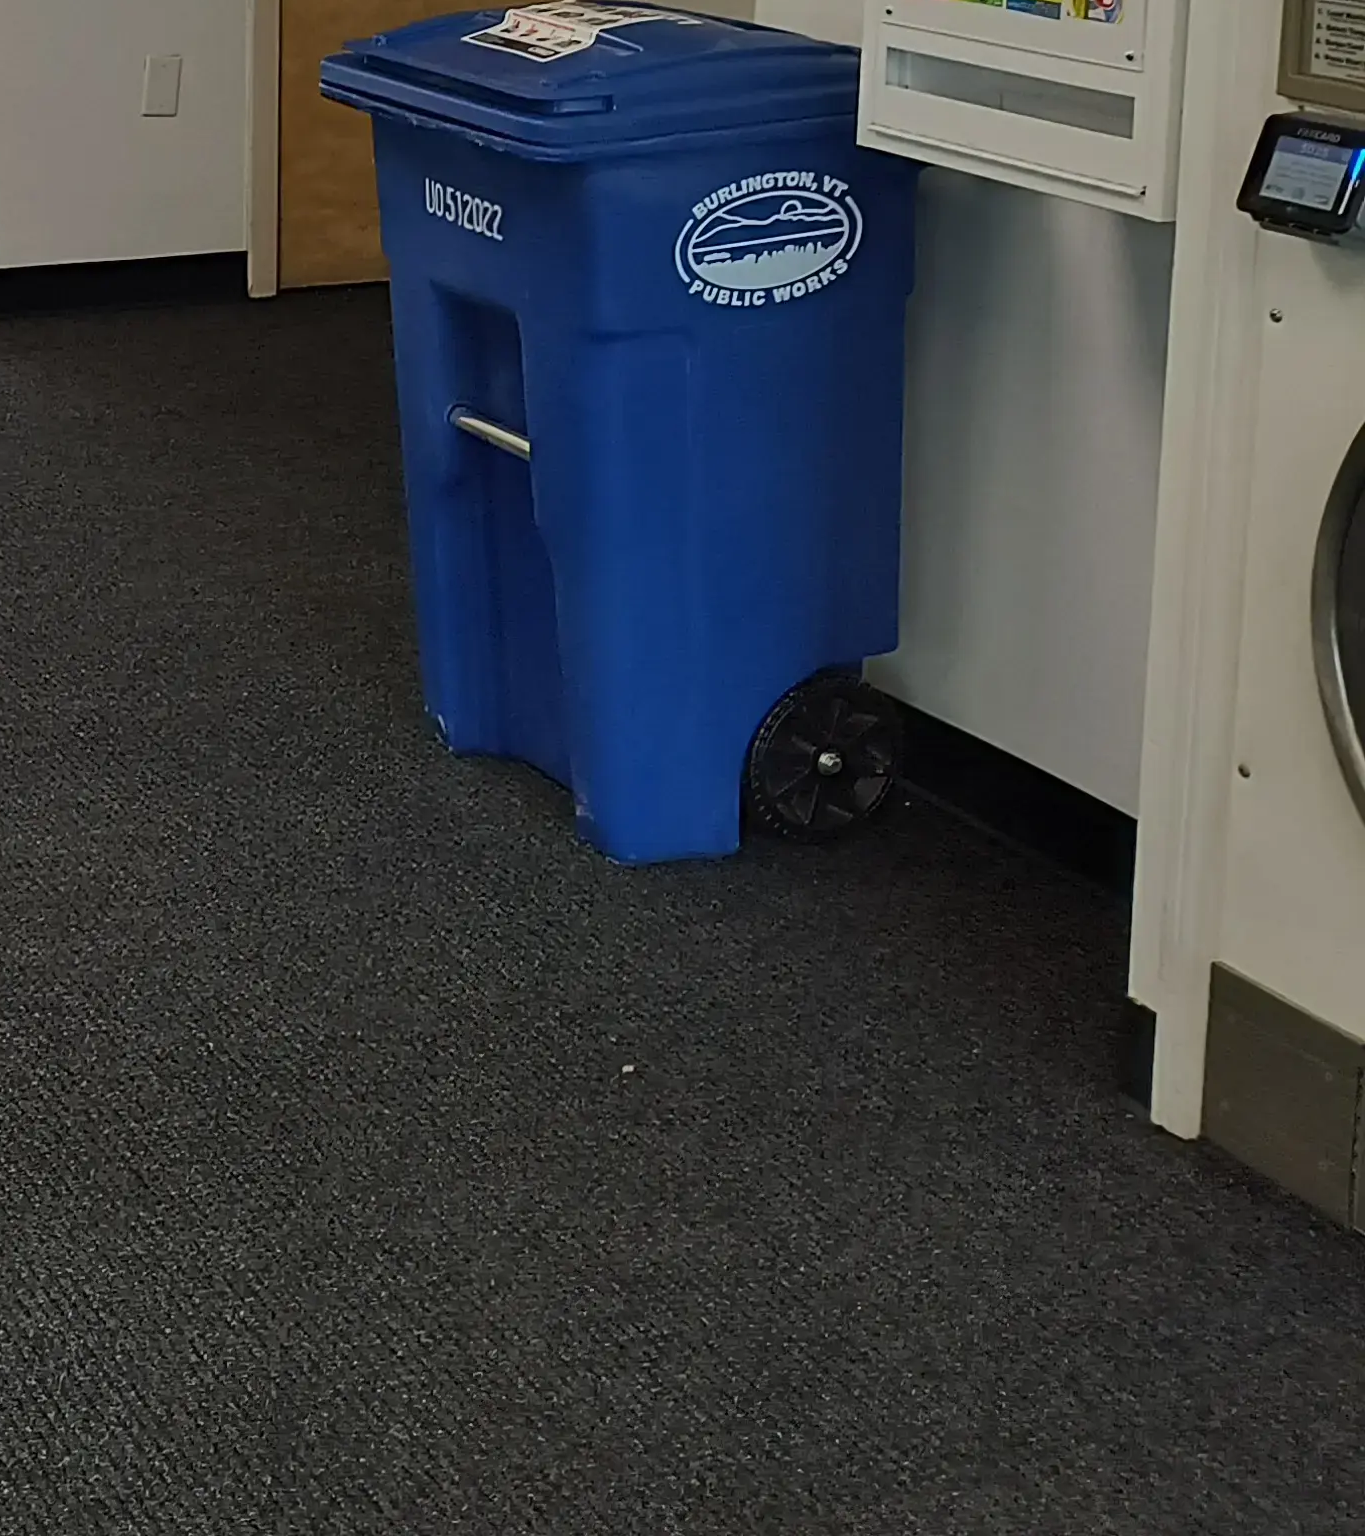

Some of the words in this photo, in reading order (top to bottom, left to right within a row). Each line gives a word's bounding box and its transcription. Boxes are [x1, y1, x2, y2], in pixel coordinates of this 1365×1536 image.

[692, 170, 818, 220] BURLINGTON,
[822, 175, 849, 198] VT
[689, 279, 766, 307] PUBLIC
[772, 258, 849, 304] WORKS
